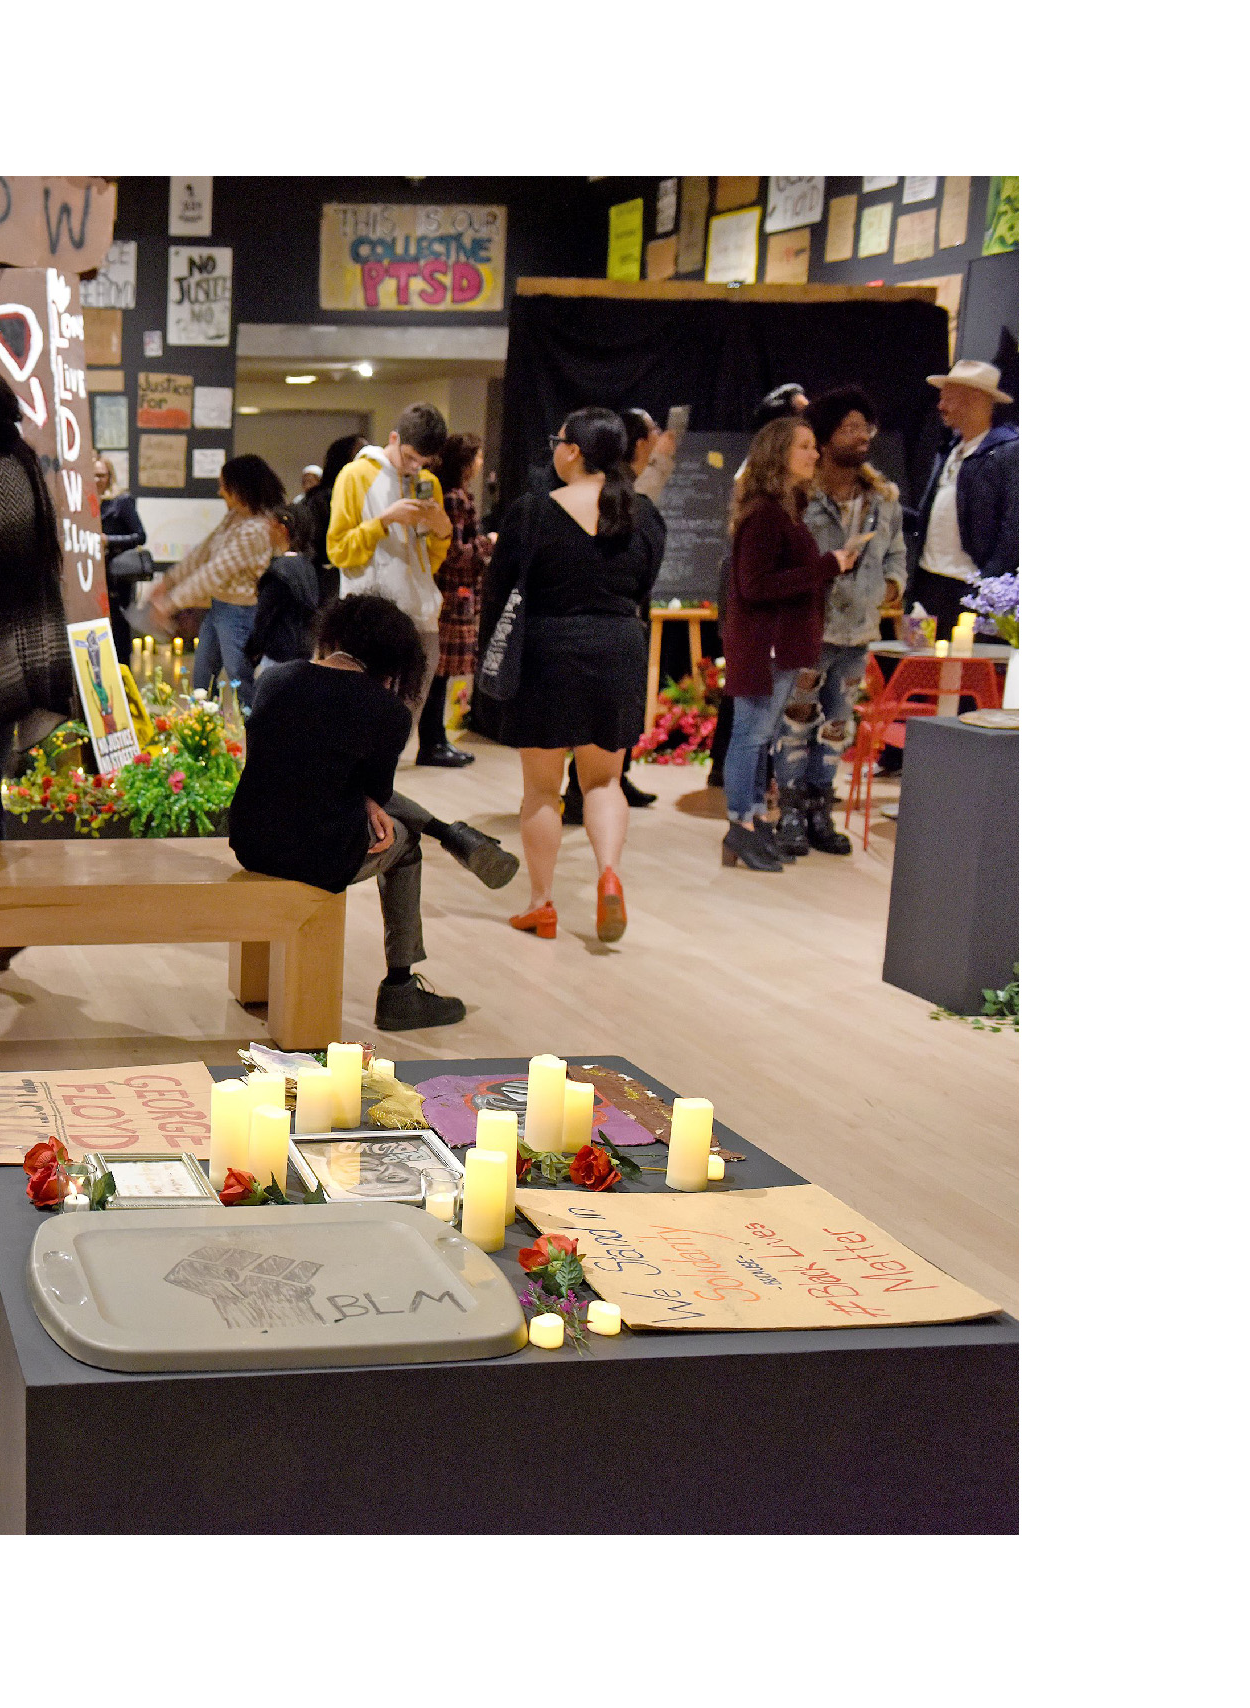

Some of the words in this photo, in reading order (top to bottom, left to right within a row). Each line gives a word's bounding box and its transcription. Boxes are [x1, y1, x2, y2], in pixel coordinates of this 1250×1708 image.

[334, 206, 396, 236] THIS
[416, 207, 444, 233] IS
[452, 209, 499, 233] OUR
[186, 254, 216, 277] NO
[350, 233, 493, 265] COLLECTIVE
[362, 258, 484, 308] PTSD
[56, 1084, 140, 1150] FLOYD
[123, 1074, 212, 1149] GEORGE
[568, 1207, 607, 1220] in
[558, 1226, 662, 1276] Stand
[744, 1222, 805, 1259] Lives
[823, 1228, 940, 1293] Matter
[635, 1225, 761, 1302] Solidarity
[326, 1289, 468, 1323] BLM
[621, 1288, 706, 1324] We
[778, 1261, 892, 1318] #Black
